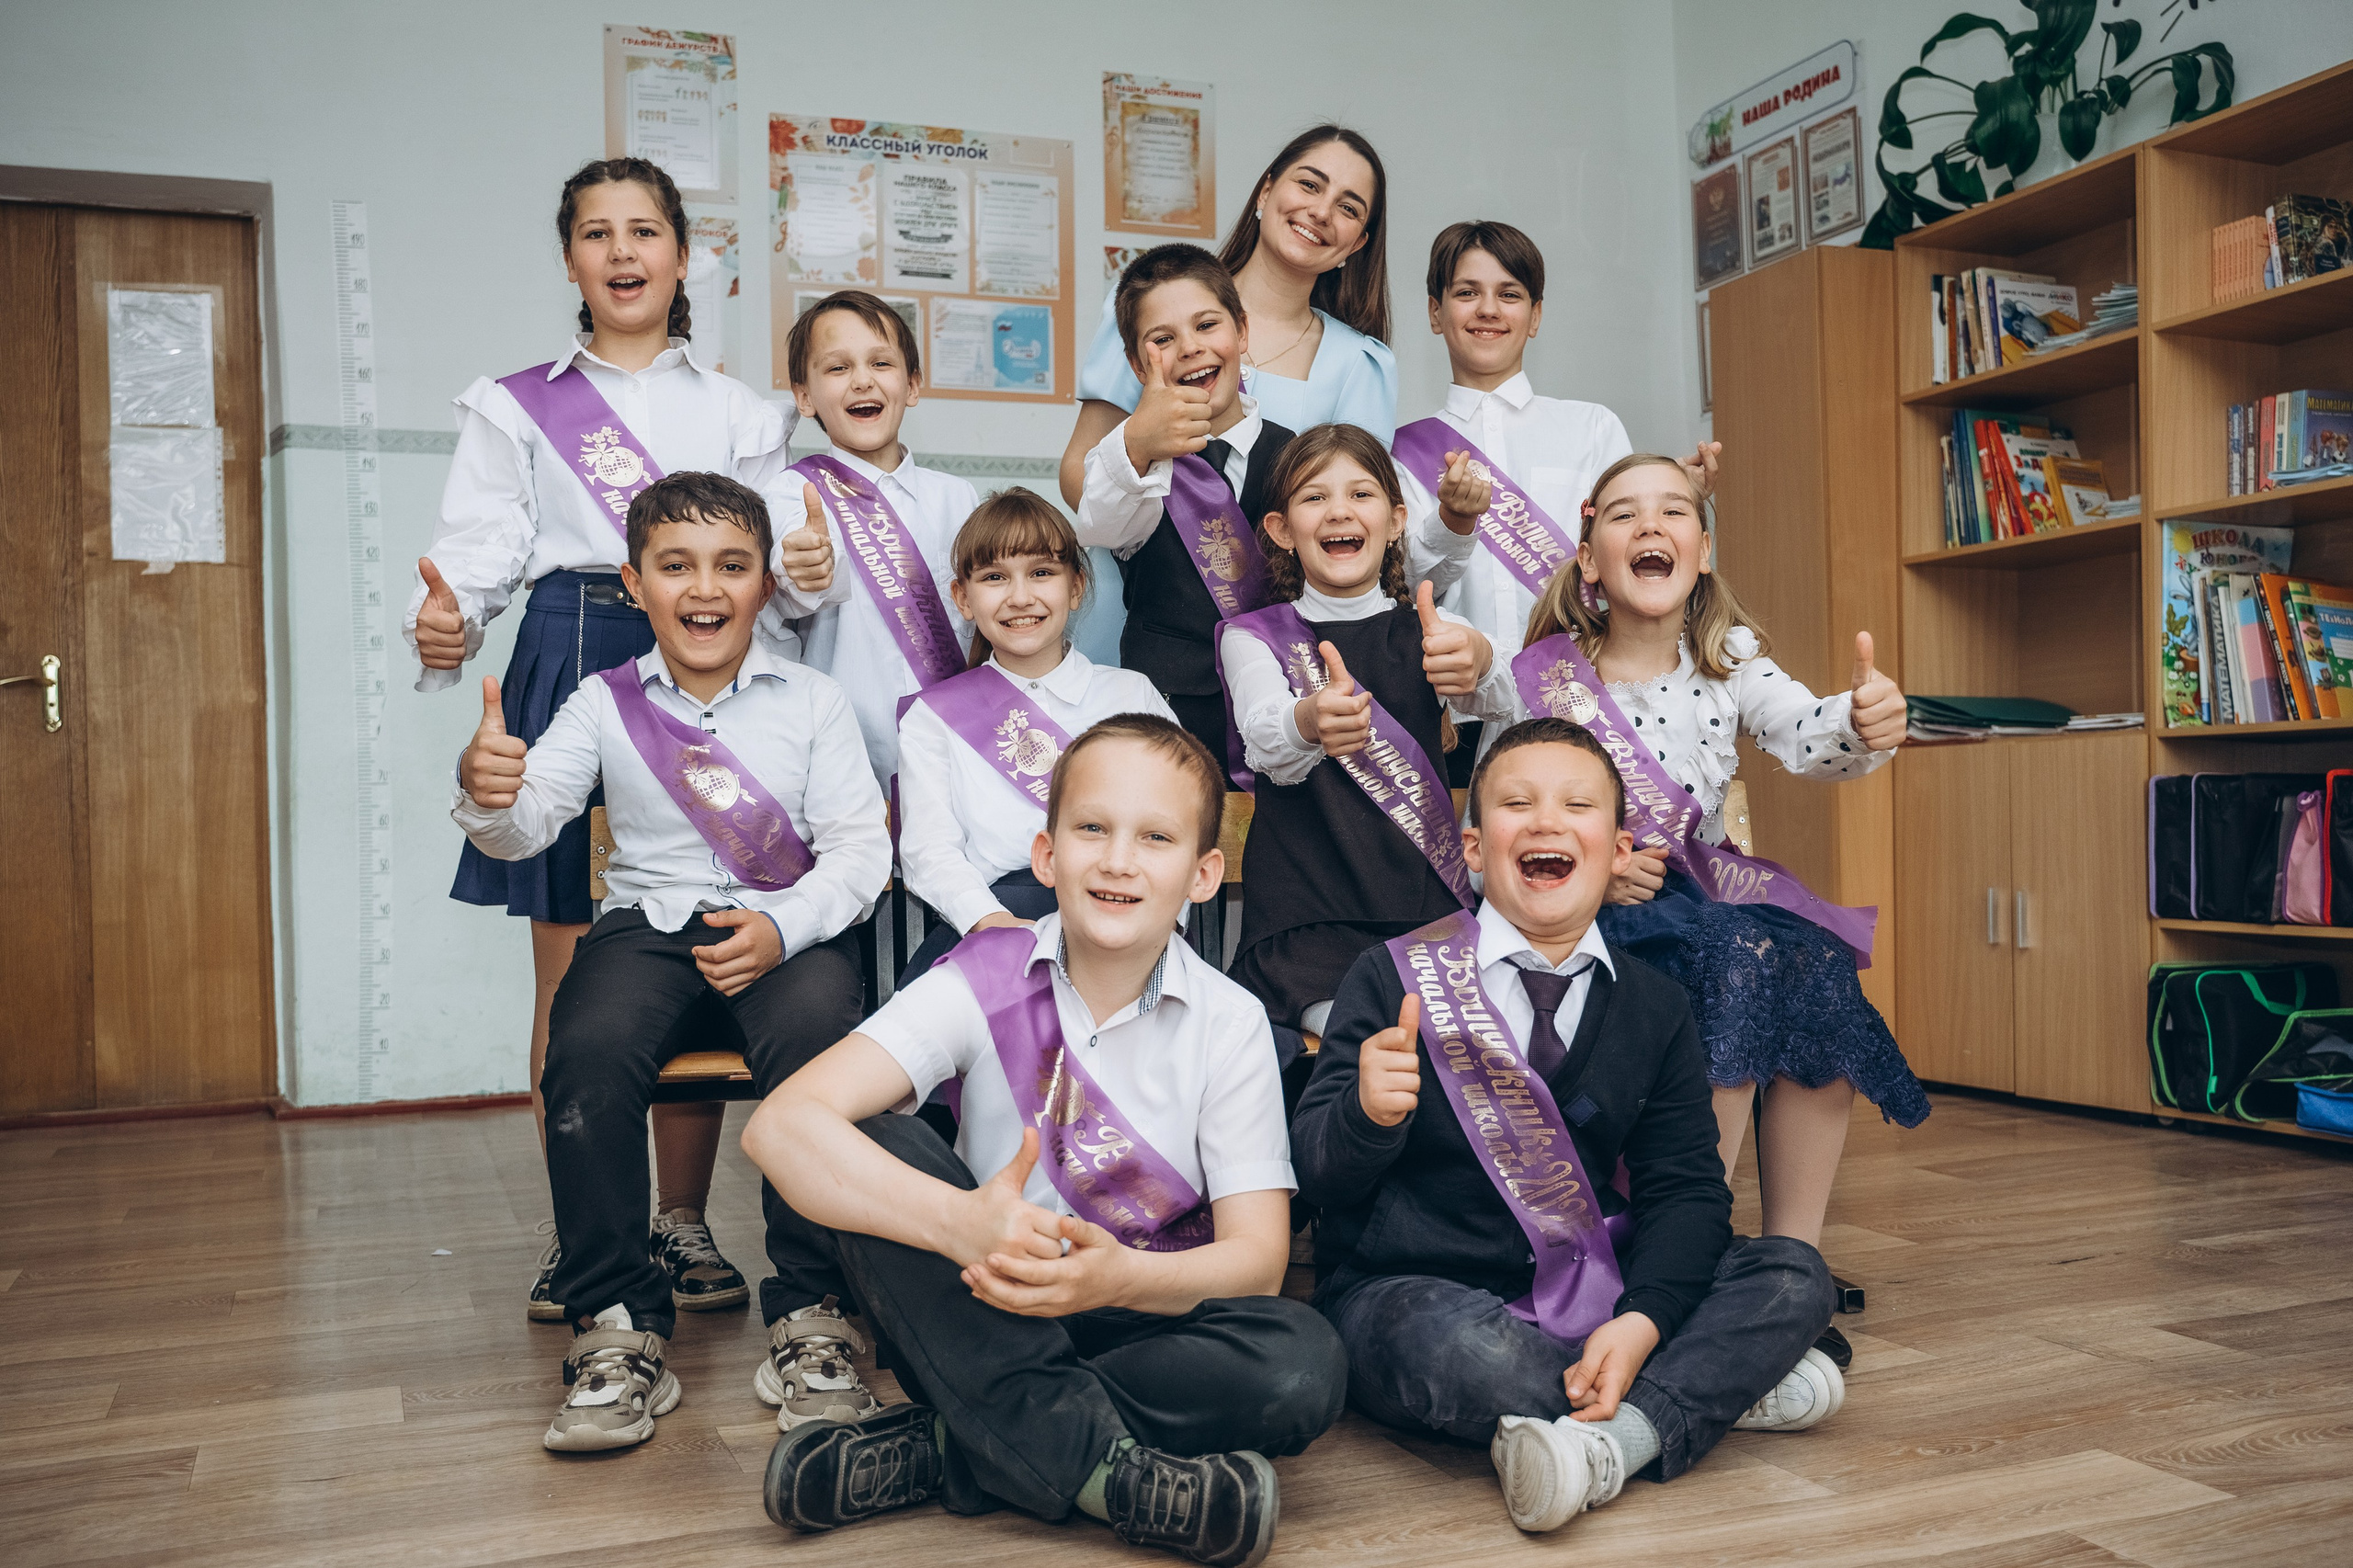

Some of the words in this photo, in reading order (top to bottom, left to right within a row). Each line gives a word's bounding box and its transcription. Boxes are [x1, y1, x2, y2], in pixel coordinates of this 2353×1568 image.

[622, 37, 663, 48] ГРАФИК
[665, 41, 720, 53] ДЕЖУРСТВ
[1114, 84, 1142, 92] НАШИ
[1143, 87, 1203, 99] ДОСТИЖЕНИЯ
[1742, 95, 1781, 127] НАША
[1782, 64, 1841, 107] РОДИНА
[826, 134, 923, 154] КЛАССНЫЙ
[926, 142, 989, 160] УГОЛОК
[351, 233, 365, 246] 190
[353, 278, 368, 291] 180
[356, 322, 369, 334] 170
[358, 367, 372, 381] 160
[2307, 396, 2353, 412] МАТЕМАТИК
[360, 412, 373, 426] 150
[362, 457, 377, 470] 140
[364, 501, 378, 515] 130
[834, 499, 905, 600] начальной
[1478, 512, 1543, 575] чальной
[2191, 528, 2265, 557] ШКОЛА
[367, 545, 380, 558] 120
[368, 590, 381, 603] 110
[370, 635, 384, 647] 100
[2211, 597, 2234, 720] МАТЕМАТИКА
[1363, 727, 1451, 845] ыпускник
[380, 813, 390, 827] 60
[1388, 801, 1445, 869] школы
[380, 858, 390, 871] 50
[381, 903, 391, 915] 40
[380, 993, 391, 1006] 20
[1437, 945, 1558, 1150] Выпускник
[1404, 941, 1480, 1074] начальной
[1461, 1081, 1525, 1177] школы
